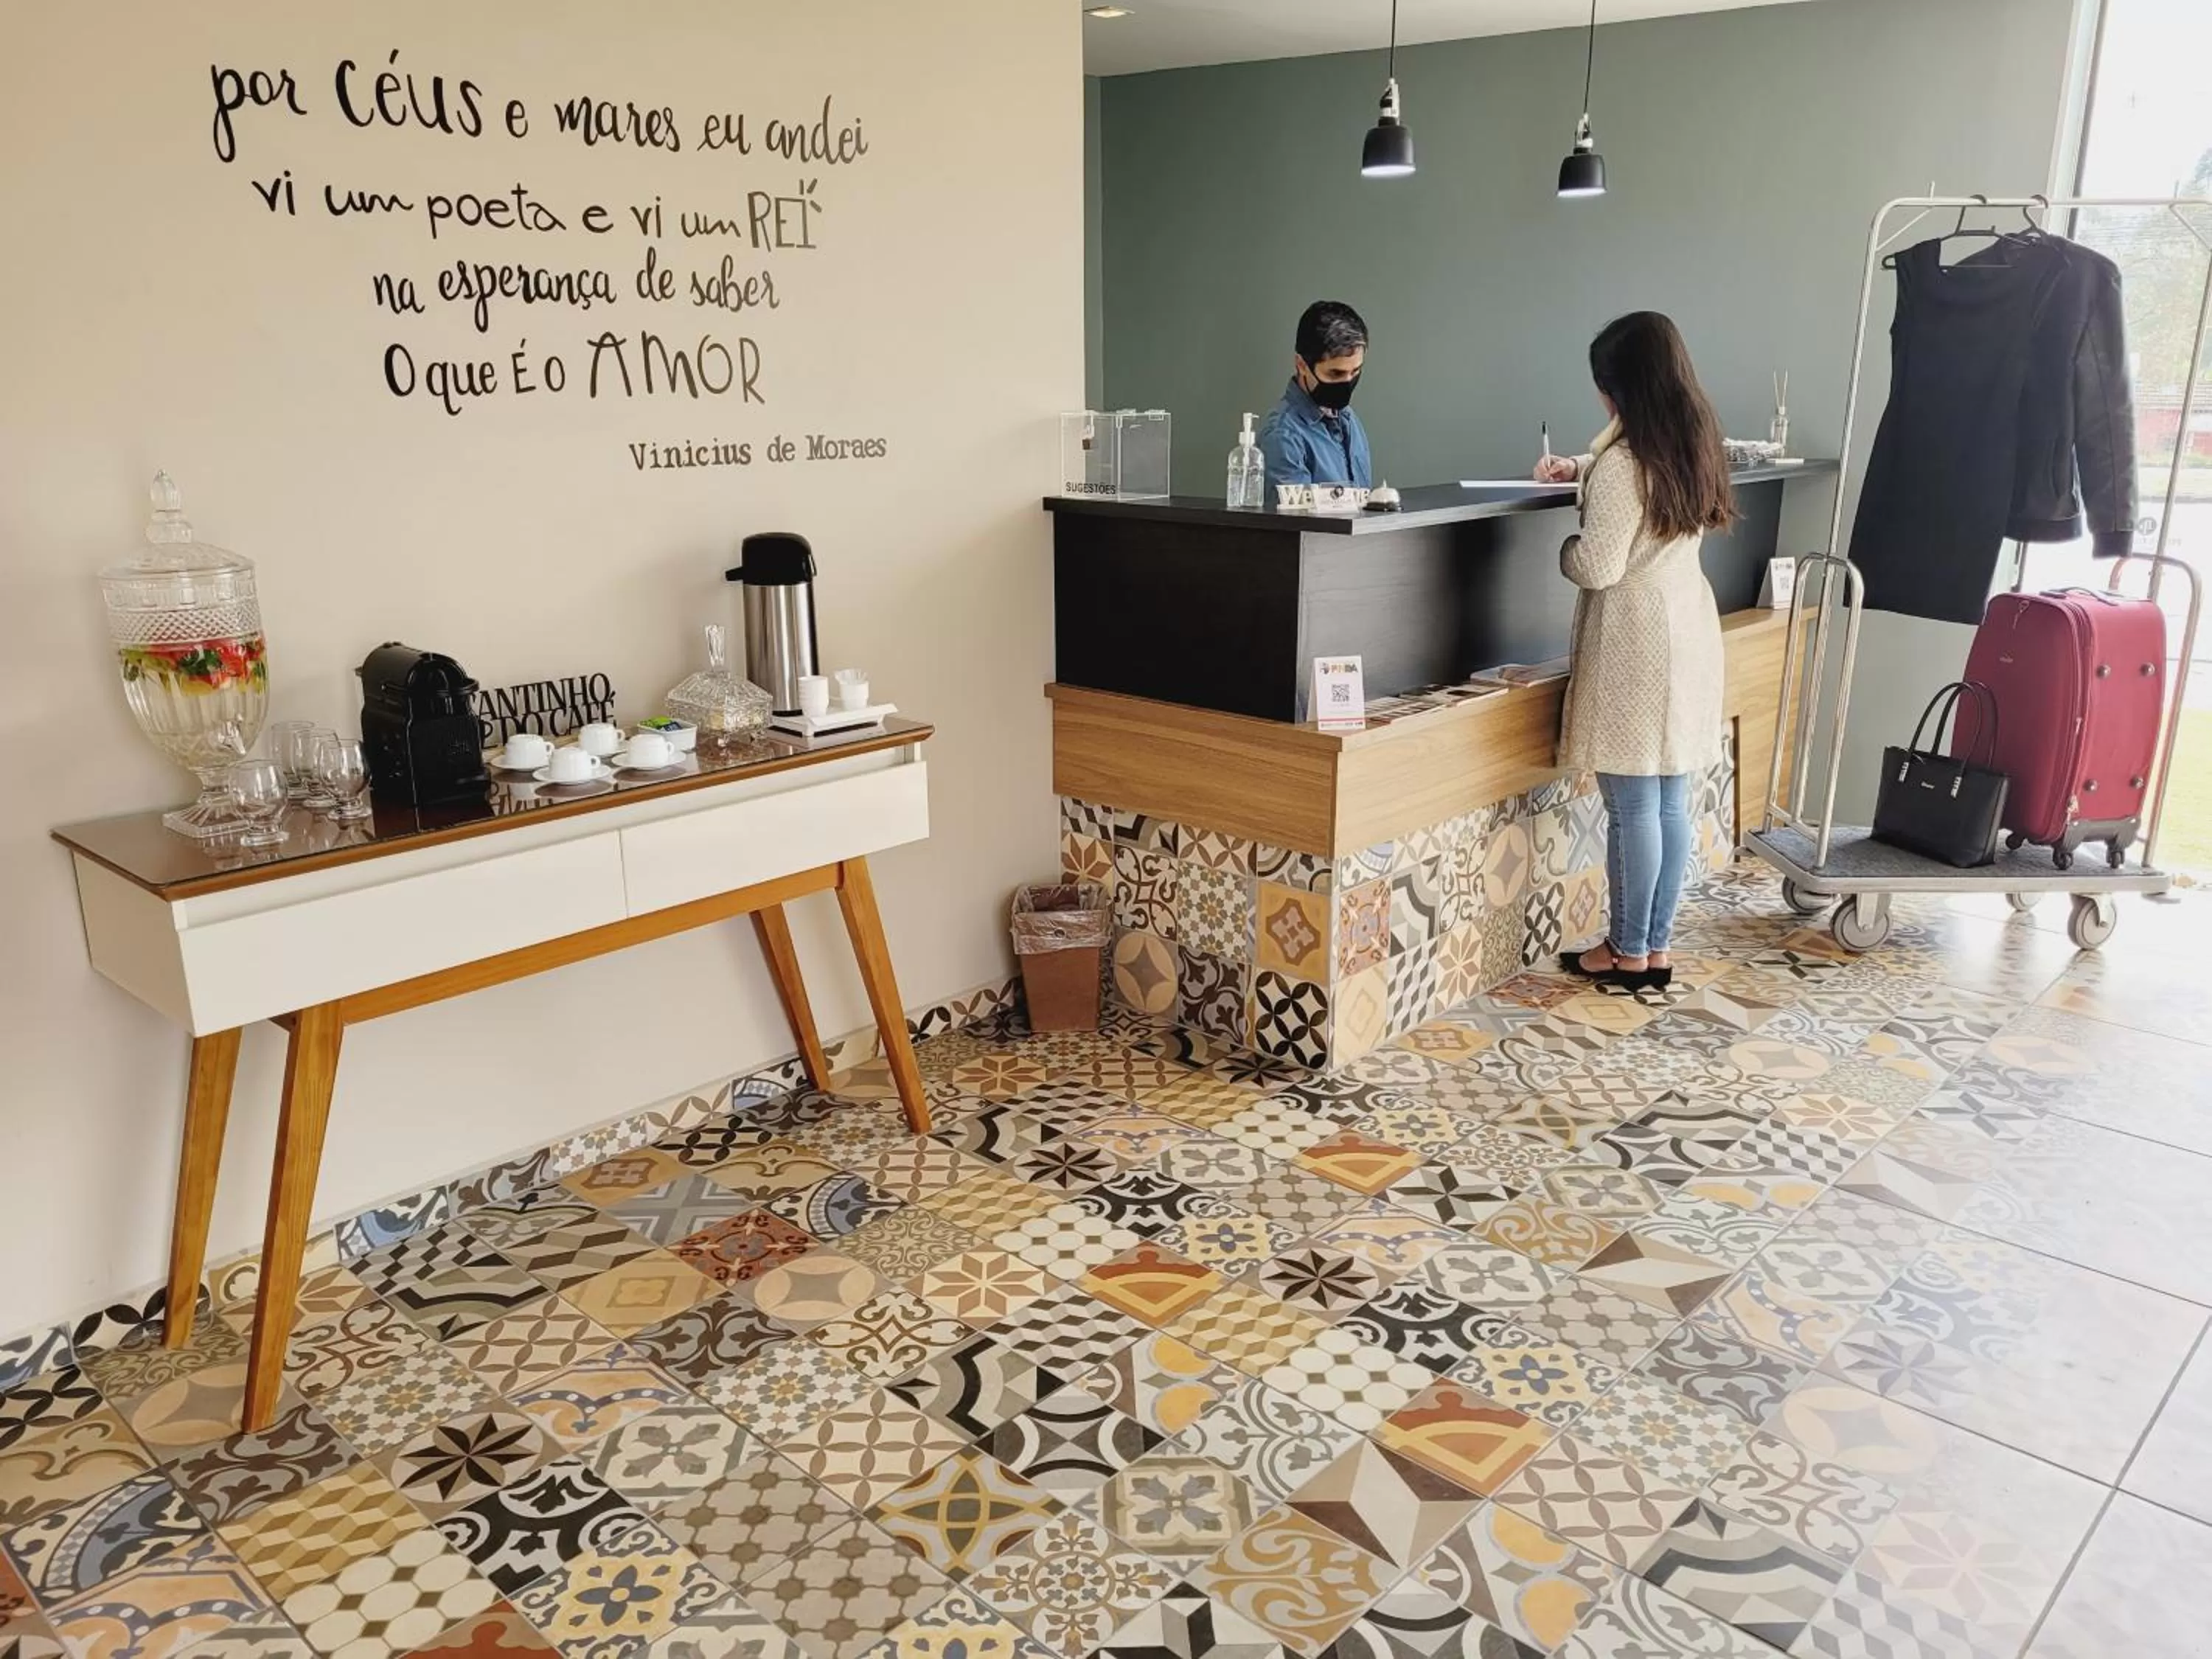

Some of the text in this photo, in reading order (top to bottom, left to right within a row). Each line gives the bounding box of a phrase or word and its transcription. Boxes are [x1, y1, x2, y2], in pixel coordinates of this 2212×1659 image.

[210, 63, 308, 164] por
[504, 99, 529, 139] e
[553, 95, 681, 153] mares
[696, 114, 752, 156] eu
[765, 94, 869, 166] andei
[250, 169, 296, 217] vi
[324, 184, 415, 217] um
[426, 182, 567, 240] poeta
[581, 204, 614, 234] e
[629, 195, 662, 240] vi
[681, 211, 742, 239] um
[372, 246, 781, 335] na esperança de saber
[586, 330, 765, 406] AMOR
[627, 434, 887, 471] Vinicius de Moraes
[1065, 481, 1116, 495] SUGESTÕES
[471, 672, 611, 720] ANTINHO
